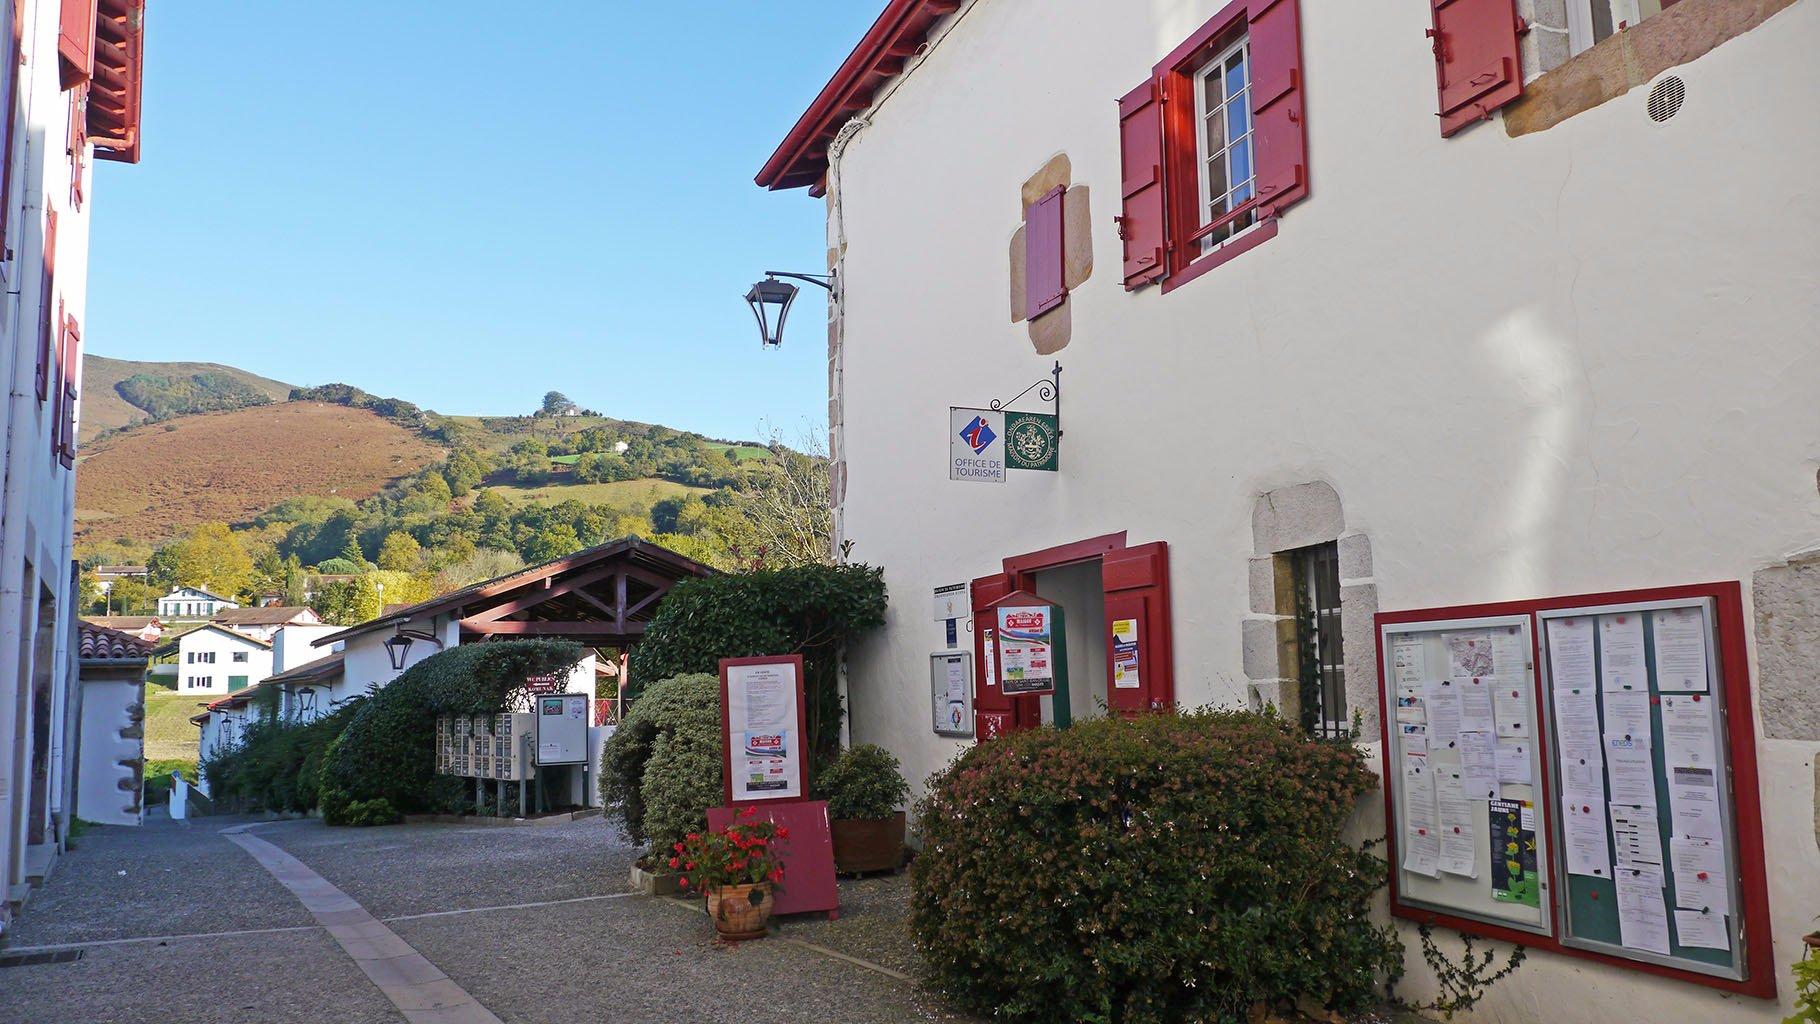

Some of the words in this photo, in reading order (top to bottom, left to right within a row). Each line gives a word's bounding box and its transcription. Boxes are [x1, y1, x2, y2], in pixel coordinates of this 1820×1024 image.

[955, 458, 986, 468] OFFICE
[989, 459, 1001, 469] DE
[955, 467, 1001, 478] TOURISME
